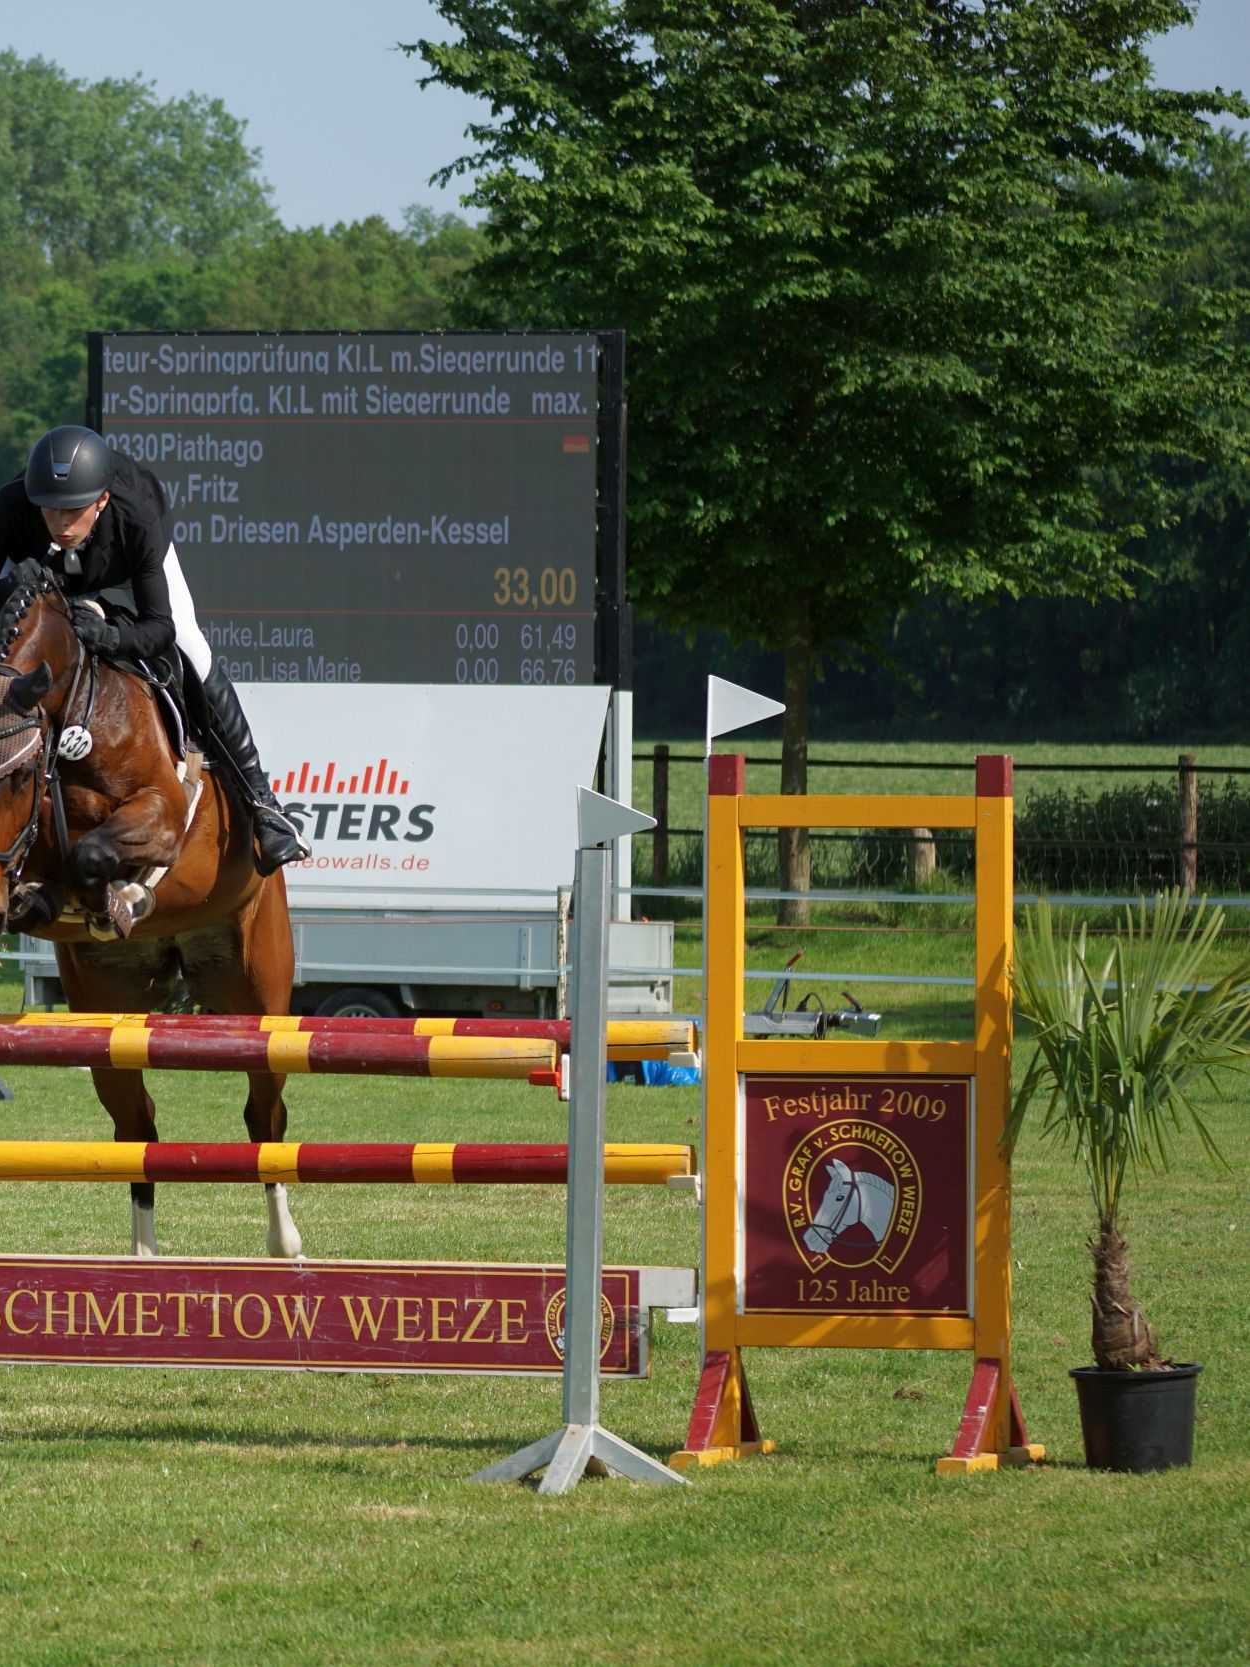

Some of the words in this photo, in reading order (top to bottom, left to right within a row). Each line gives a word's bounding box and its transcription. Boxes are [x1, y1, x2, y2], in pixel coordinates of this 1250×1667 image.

[321, 385, 359, 414] mit
[366, 385, 510, 416] Siegerrunde
[532, 391, 588, 414] max.
[158, 473, 239, 509] y,Fritz
[173, 520, 202, 543] on
[211, 514, 299, 544] Driesen
[307, 514, 509, 551] Asperden-Kessel
[493, 566, 577, 610] 33,00
[456, 623, 499, 652] 0,00
[520, 623, 576, 652] 61,49
[307, 655, 362, 683] Marie
[283, 801, 437, 843] STERS
[762, 1086, 872, 1122] Festjahr
[878, 1088, 946, 1122] 2009
[789, 1146, 814, 1192] GRAF
[829, 1124, 914, 1179] SCHMETTOW
[896, 1185, 916, 1236] WEEZE
[797, 1279, 837, 1302] 125
[846, 1279, 911, 1303] Jahre
[339, 1295, 530, 1344] WEEZE
